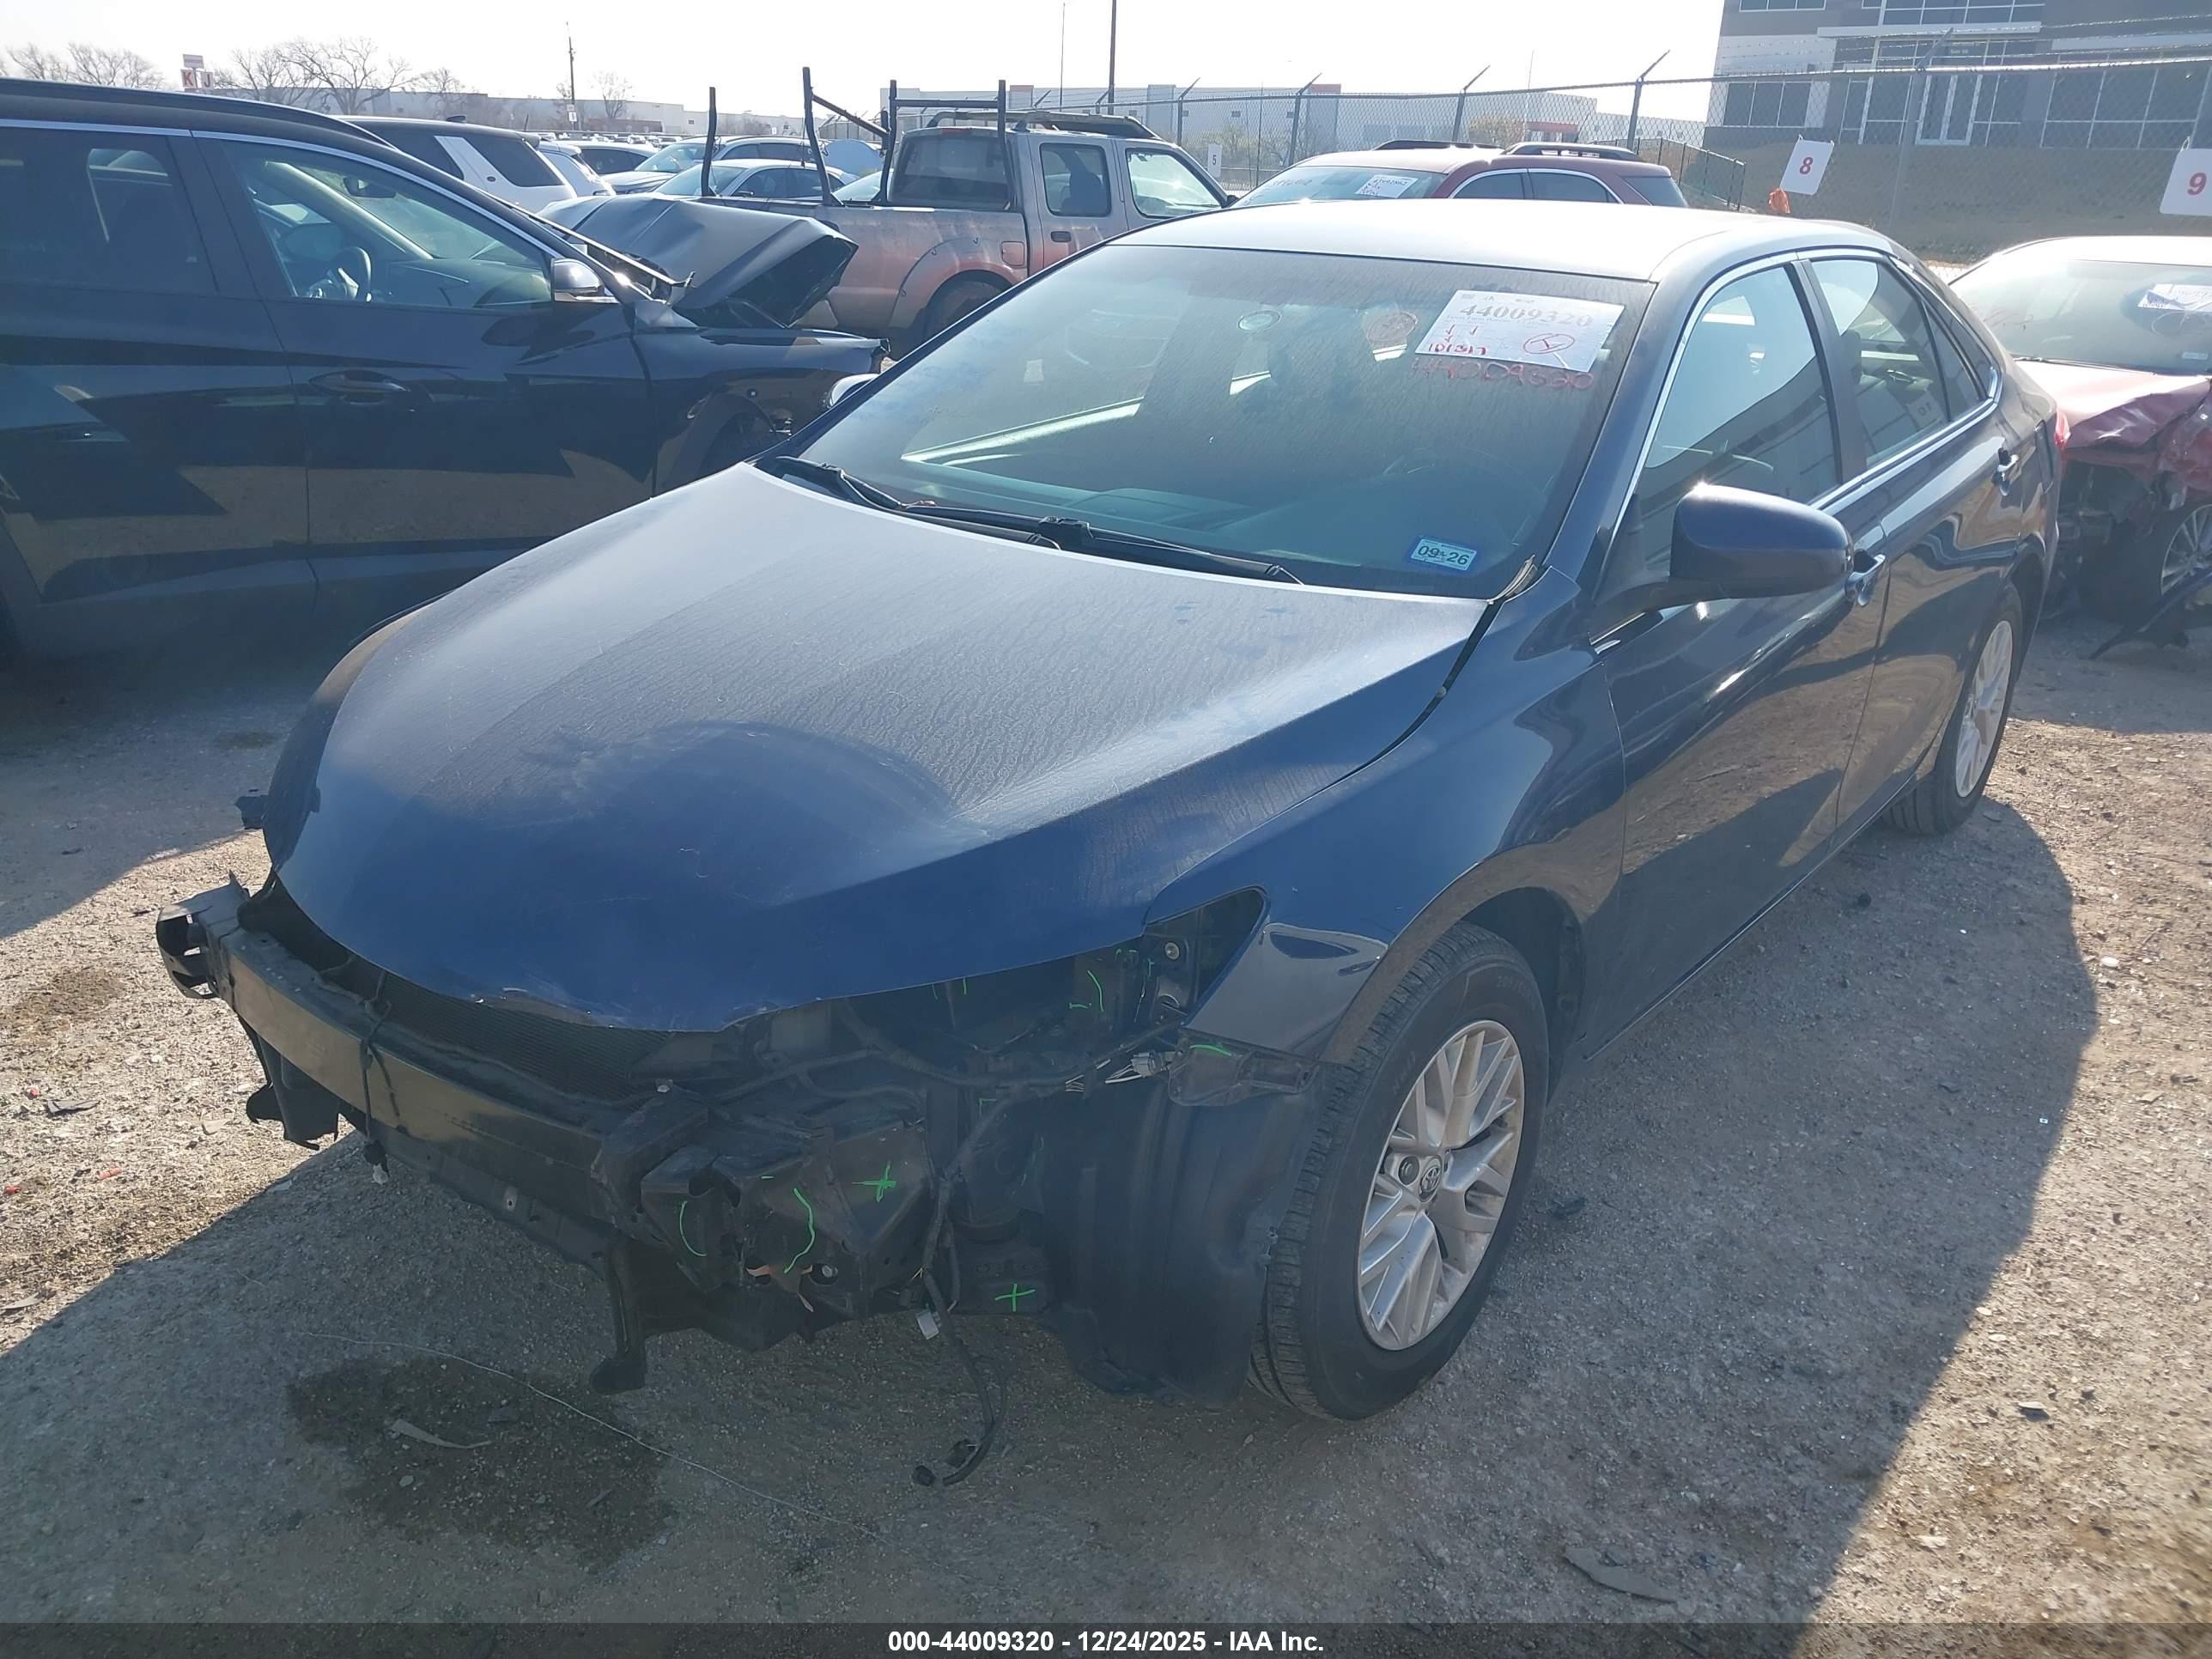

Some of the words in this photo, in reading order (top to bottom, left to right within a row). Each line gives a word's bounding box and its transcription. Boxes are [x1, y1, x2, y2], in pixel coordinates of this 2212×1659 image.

[1212, 154, 1217, 166] 5
[1799, 156, 1814, 175] 8
[2187, 172, 2208, 196] 9
[1460, 304, 1594, 327] 44009320
